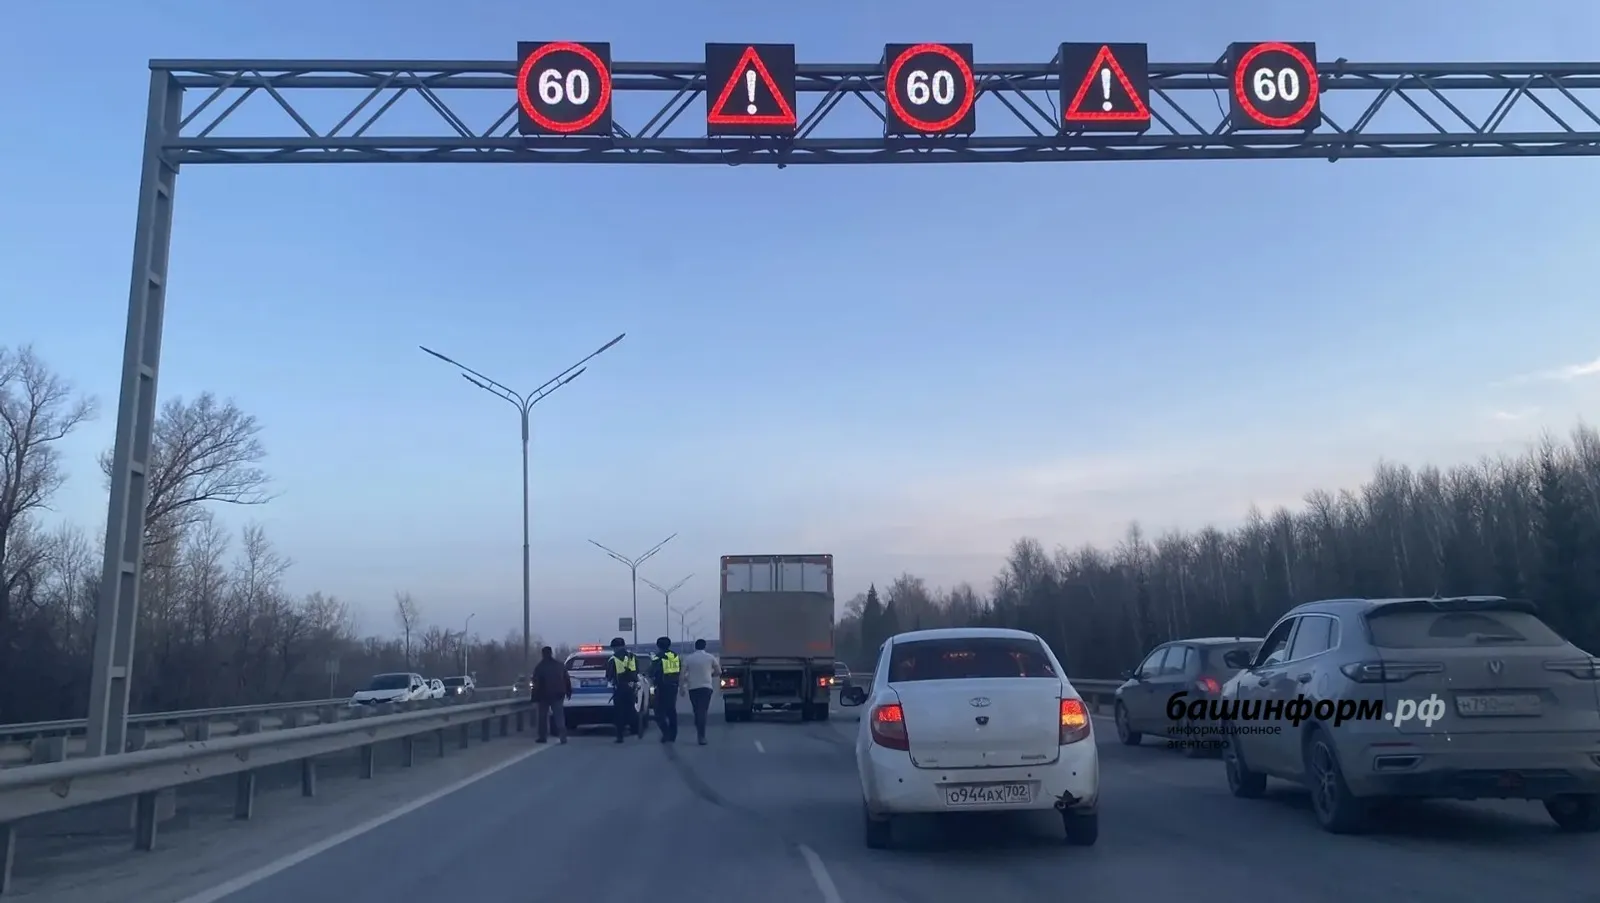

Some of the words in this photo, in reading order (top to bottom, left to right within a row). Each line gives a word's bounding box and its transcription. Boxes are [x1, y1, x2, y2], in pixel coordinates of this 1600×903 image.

[538, 68, 590, 105] 60
[906, 69, 955, 105] 60
[1253, 67, 1300, 102] 60
[1005, 785, 1026, 797] 702
